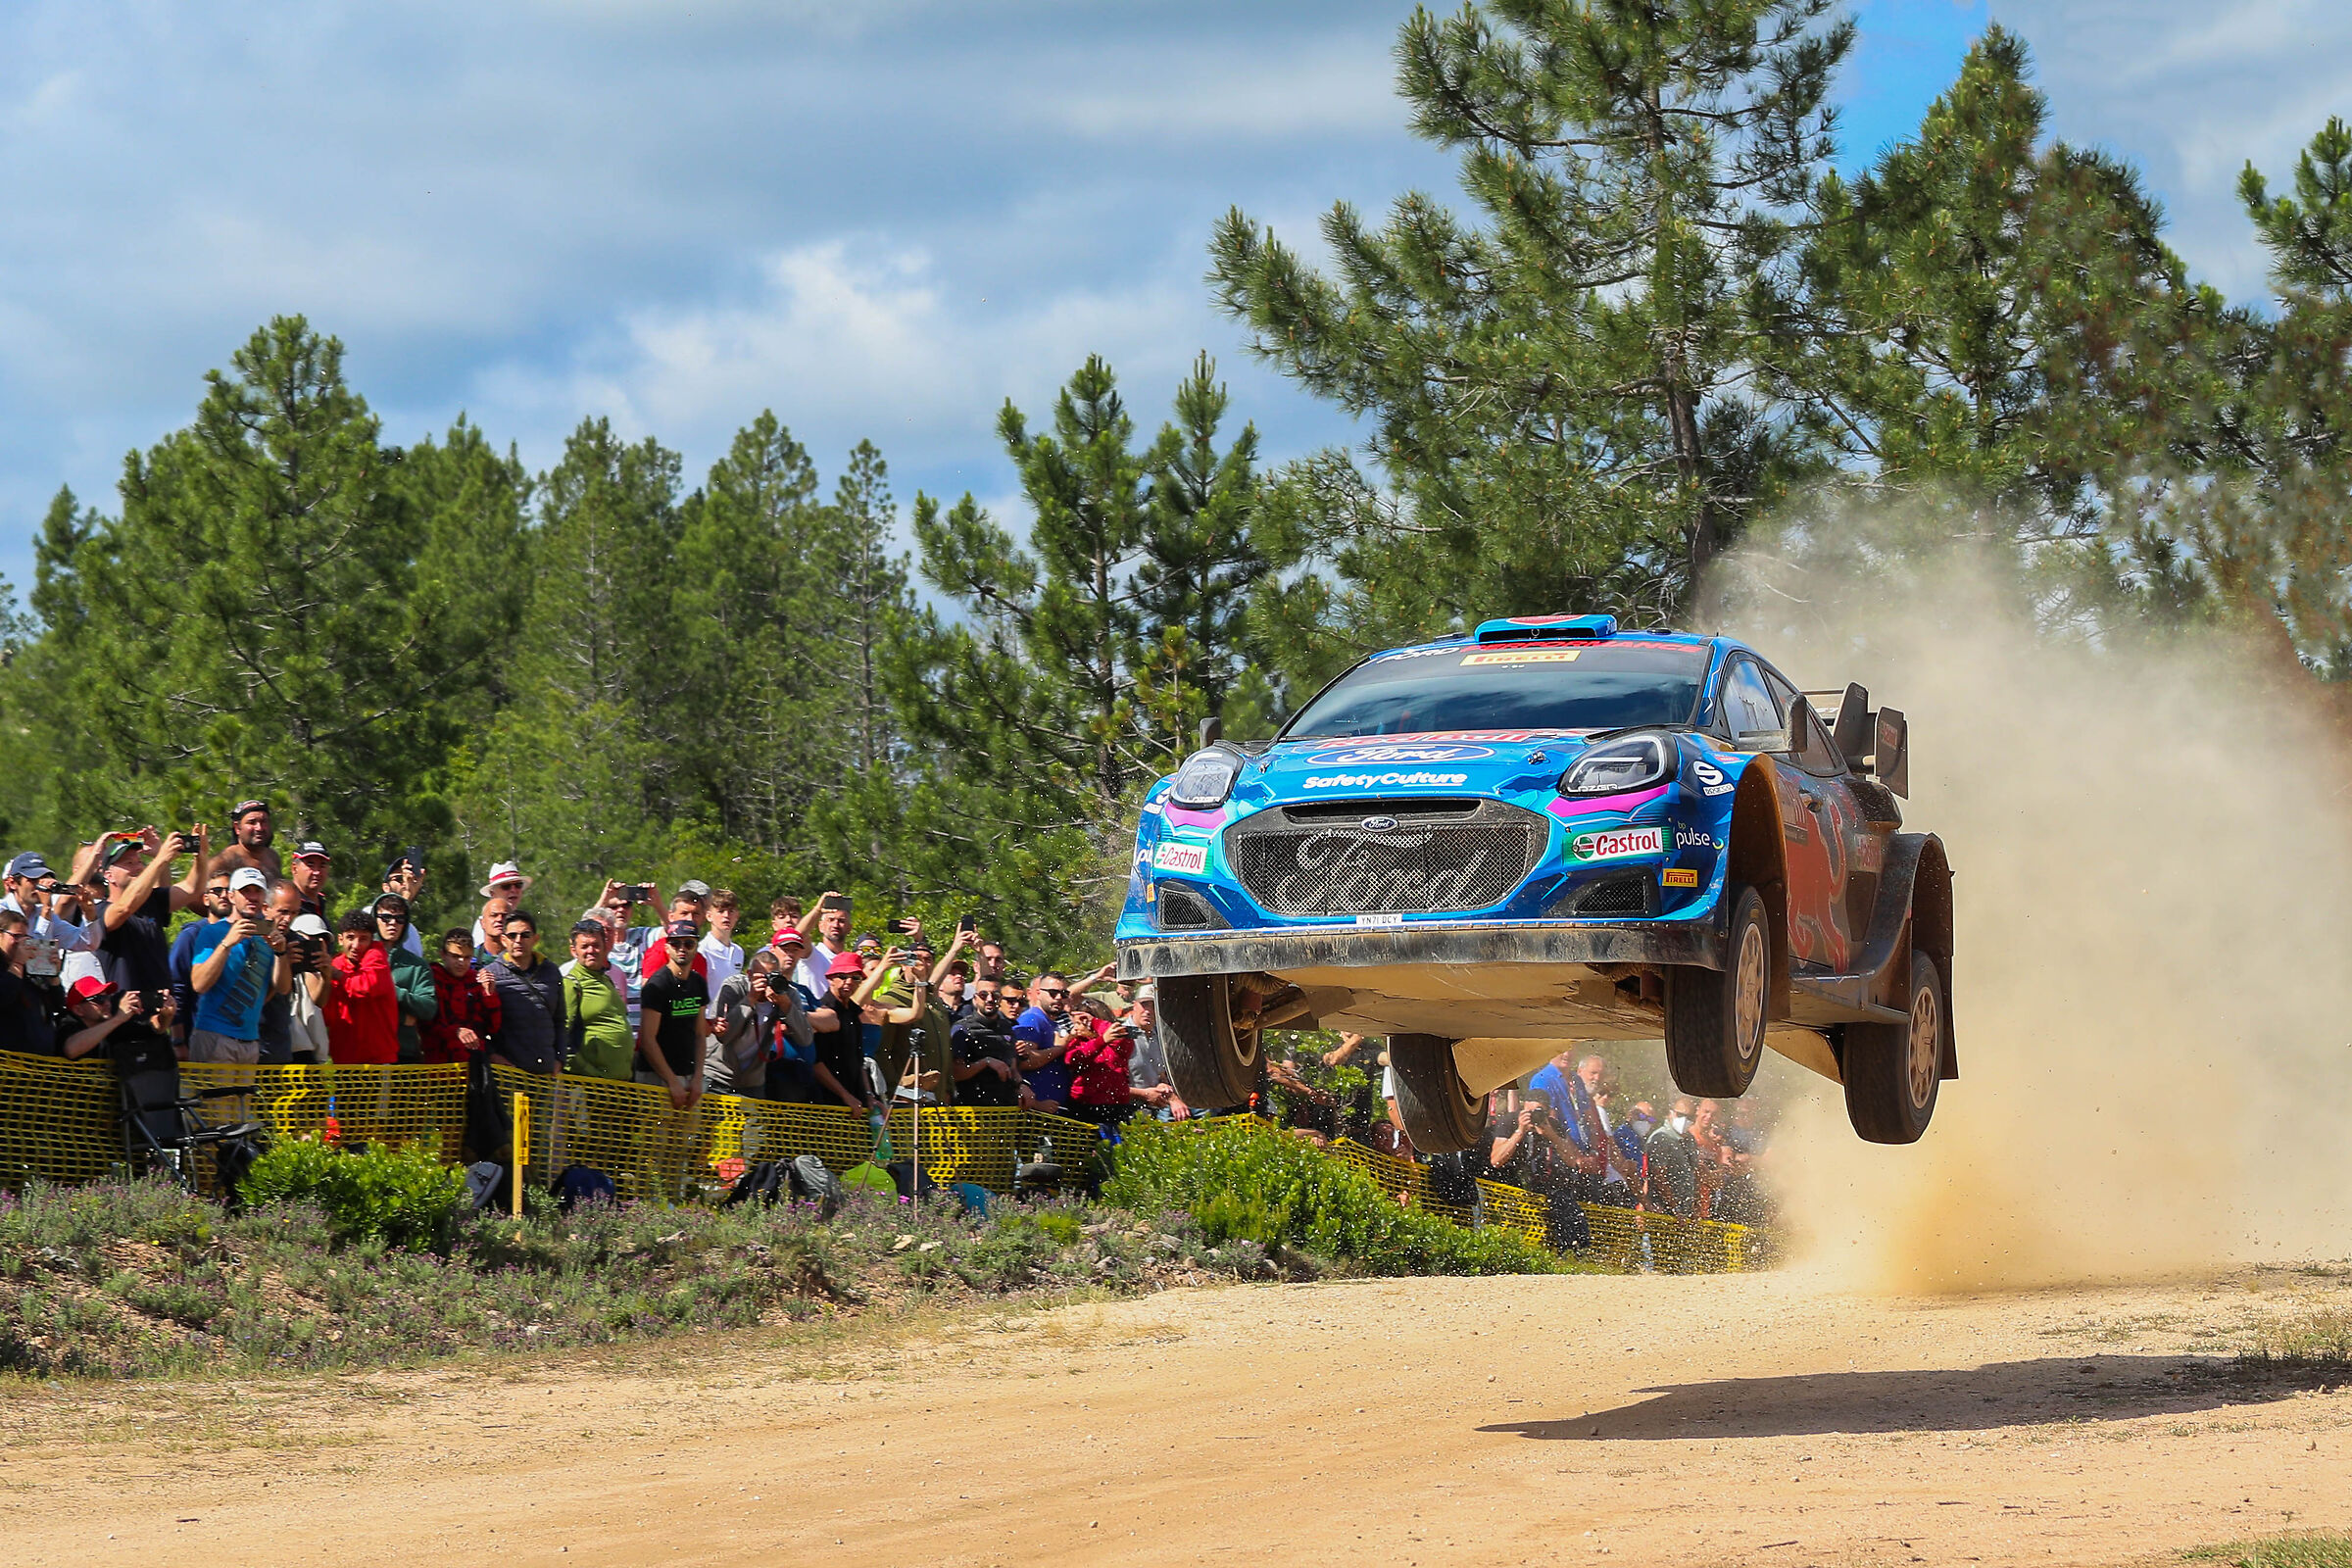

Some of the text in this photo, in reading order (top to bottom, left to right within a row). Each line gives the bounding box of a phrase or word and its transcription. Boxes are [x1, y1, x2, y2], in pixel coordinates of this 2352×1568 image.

[1460, 640, 1704, 653] PERFORMANCE
[1474, 651, 1569, 663] PIRELLI
[1336, 745, 1463, 761] Ford
[1302, 771, 1468, 788] SafetyCulture
[1595, 831, 1659, 856] Castrol
[1676, 827, 1711, 850] pulse
[1164, 846, 1202, 870] Castrol
[1276, 830, 1488, 911] Ford
[1666, 871, 1694, 884] PIRELLI
